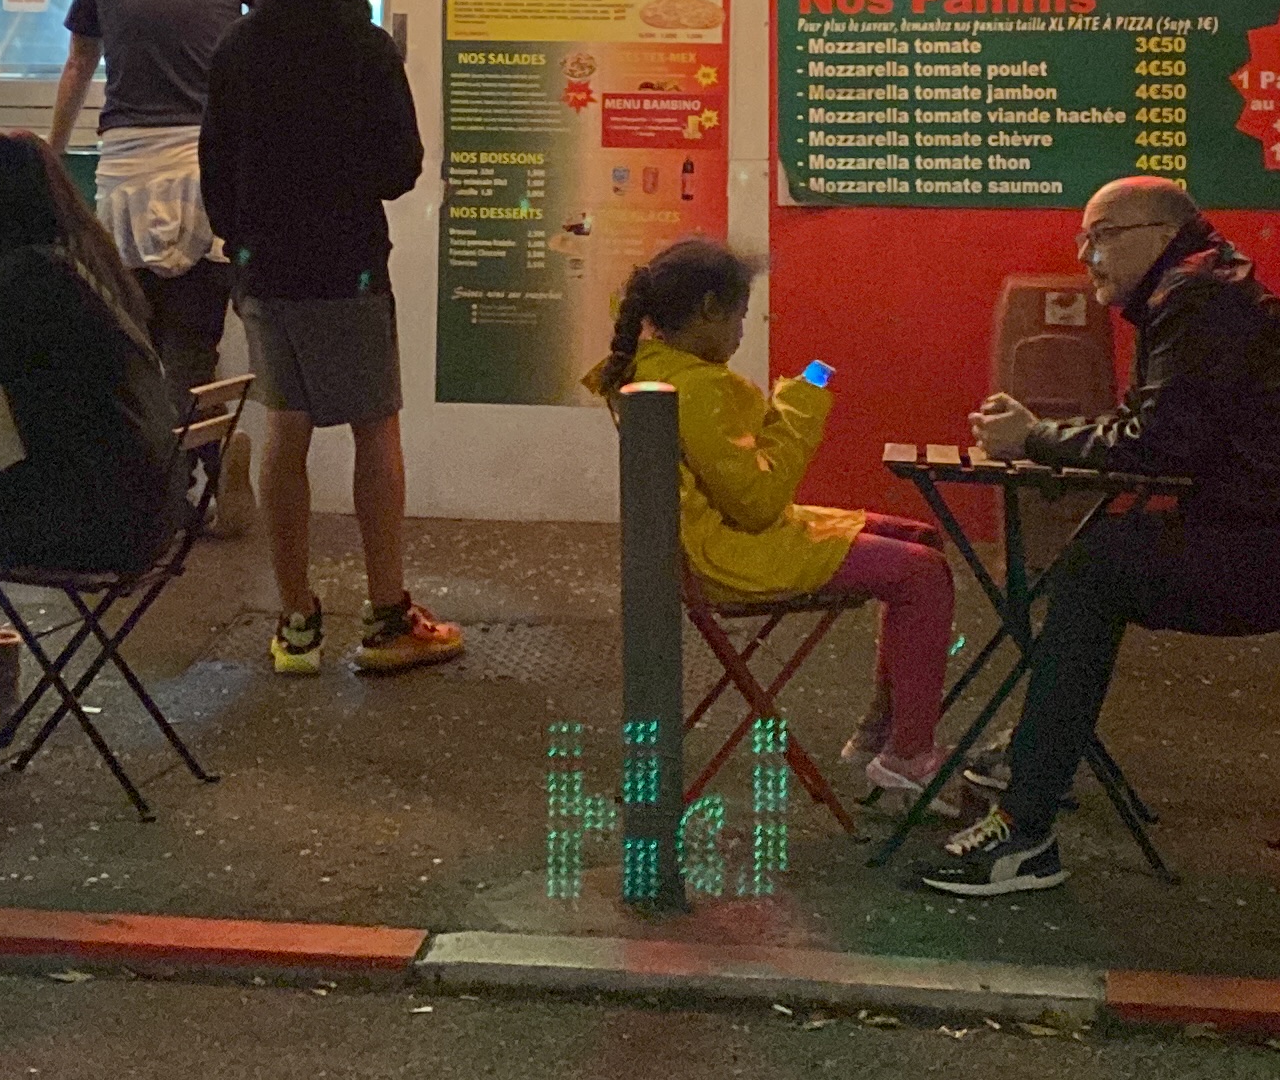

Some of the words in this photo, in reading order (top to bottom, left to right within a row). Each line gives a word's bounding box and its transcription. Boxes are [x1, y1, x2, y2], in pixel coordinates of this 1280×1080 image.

[822, 18, 846, 36] plus
[848, 18, 860, 32] de
[1048, 16, 1065, 32] XL
[1115, 16, 1154, 32] PIZZA
[808, 38, 910, 54] Mozzarella
[914, 38, 982, 54] tomate
[1135, 36, 1187, 53] 3€50
[457, 52, 486, 65] NOS
[488, 52, 546, 66] SALADES
[808, 61, 910, 77] Mozzarella
[914, 61, 982, 77] tomate
[987, 61, 1047, 80] poulet
[1135, 60, 1187, 77] 4€50
[1237, 72, 1250, 89] 1
[808, 85, 910, 101] Mozzarella
[914, 85, 982, 101] tomate
[986, 84, 1057, 103] jambon
[1135, 83, 1187, 100] 4€50
[604, 98, 640, 111] MENU
[642, 98, 701, 112] BAMBINO
[1250, 99, 1274, 111] au
[808, 108, 910, 124] Mozzarella
[914, 108, 982, 124] tomate
[987, 107, 1051, 123] viande
[1056, 107, 1126, 123] hachée
[1135, 107, 1187, 123] 4€50
[808, 131, 910, 147] Mozzarella
[914, 131, 982, 147] tomate
[987, 130, 1053, 147] chèvre
[1135, 130, 1187, 147] 4€50
[450, 151, 477, 164] NOS
[479, 152, 545, 165] BOISSONS
[808, 154, 910, 170] Mozzarella
[914, 154, 982, 170] tomate
[988, 154, 1031, 171] thon
[1135, 154, 1187, 171] 4€50
[808, 177, 910, 194] Mozzarella
[914, 177, 982, 194] tomate
[988, 179, 1063, 194] saumon
[450, 207, 476, 220] NOS
[478, 207, 543, 221] DESSERTS
